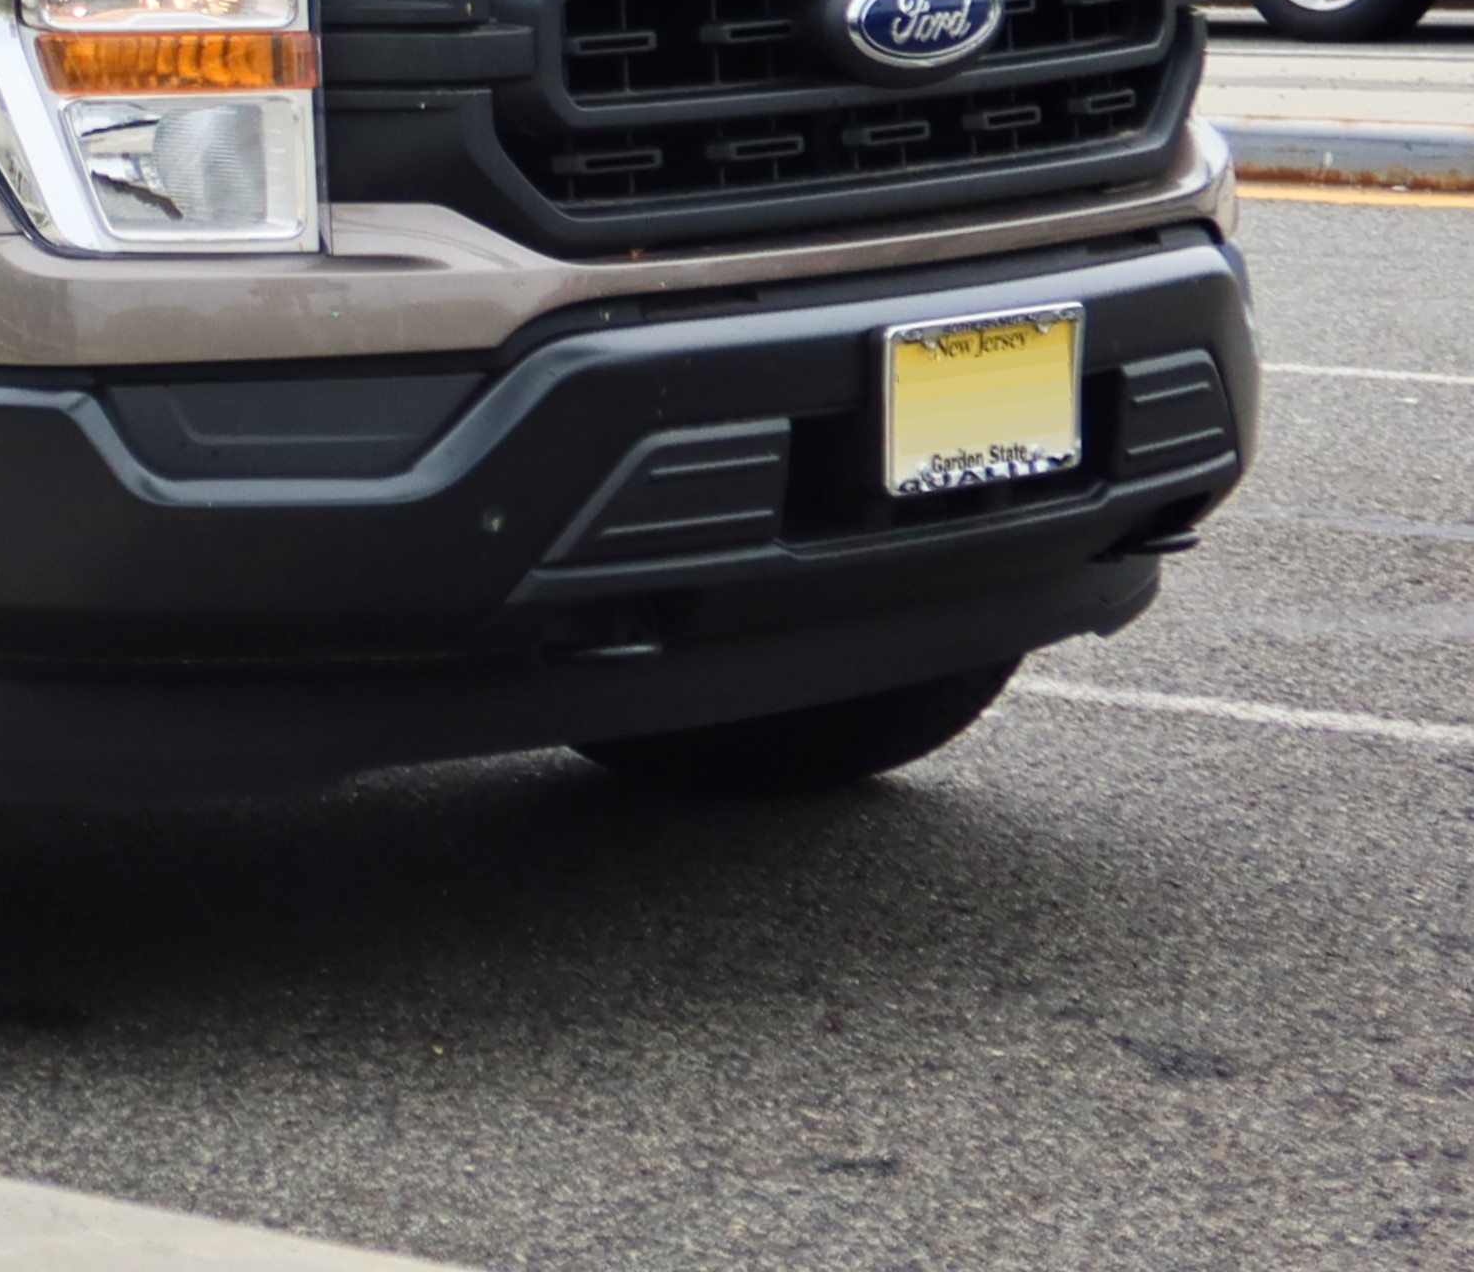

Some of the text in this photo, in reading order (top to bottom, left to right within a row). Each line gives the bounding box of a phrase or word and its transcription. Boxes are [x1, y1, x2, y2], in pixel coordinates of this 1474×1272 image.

[975, 328, 1030, 357] Jersey
[931, 442, 1028, 473] Garden State
